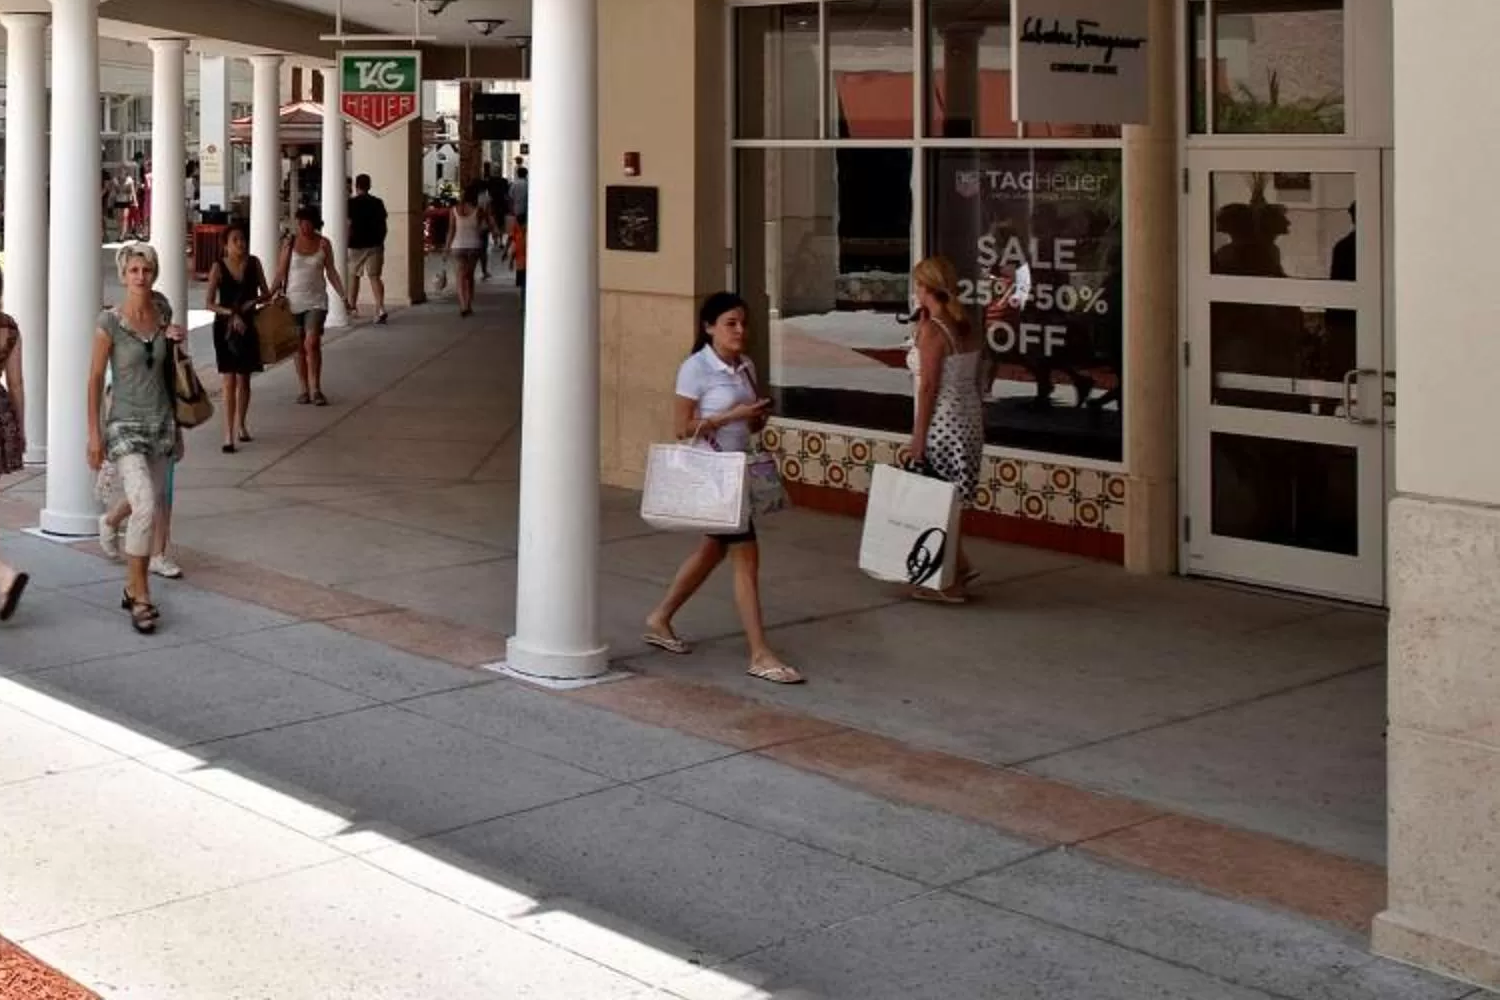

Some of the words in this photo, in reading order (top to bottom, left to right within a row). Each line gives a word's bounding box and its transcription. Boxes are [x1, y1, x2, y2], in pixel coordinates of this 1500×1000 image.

[353, 60, 405, 90] TAG
[345, 95, 411, 127] HEUER
[976, 235, 1077, 271] SALE
[986, 321, 1067, 356] OFF
